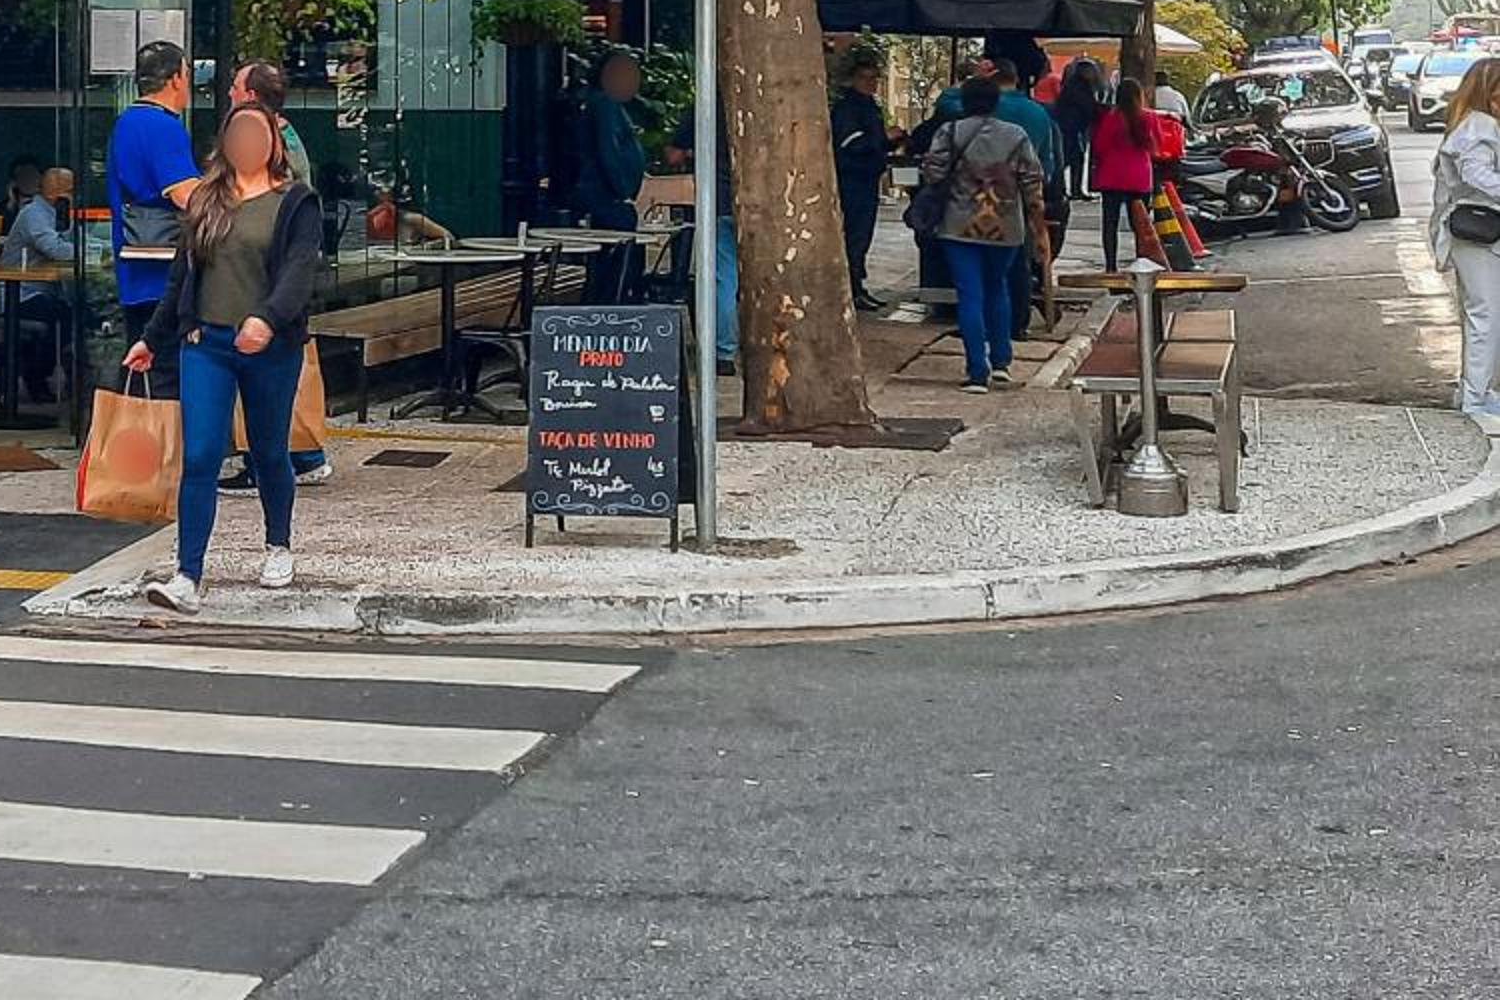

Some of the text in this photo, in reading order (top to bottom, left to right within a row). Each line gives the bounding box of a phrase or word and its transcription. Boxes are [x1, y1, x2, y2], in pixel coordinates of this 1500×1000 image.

[553, 335, 652, 352] MENU DO DIA
[579, 351, 625, 367] PRATO
[601, 370, 618, 389] de
[539, 431, 655, 450] TAÇA DE VINHO
